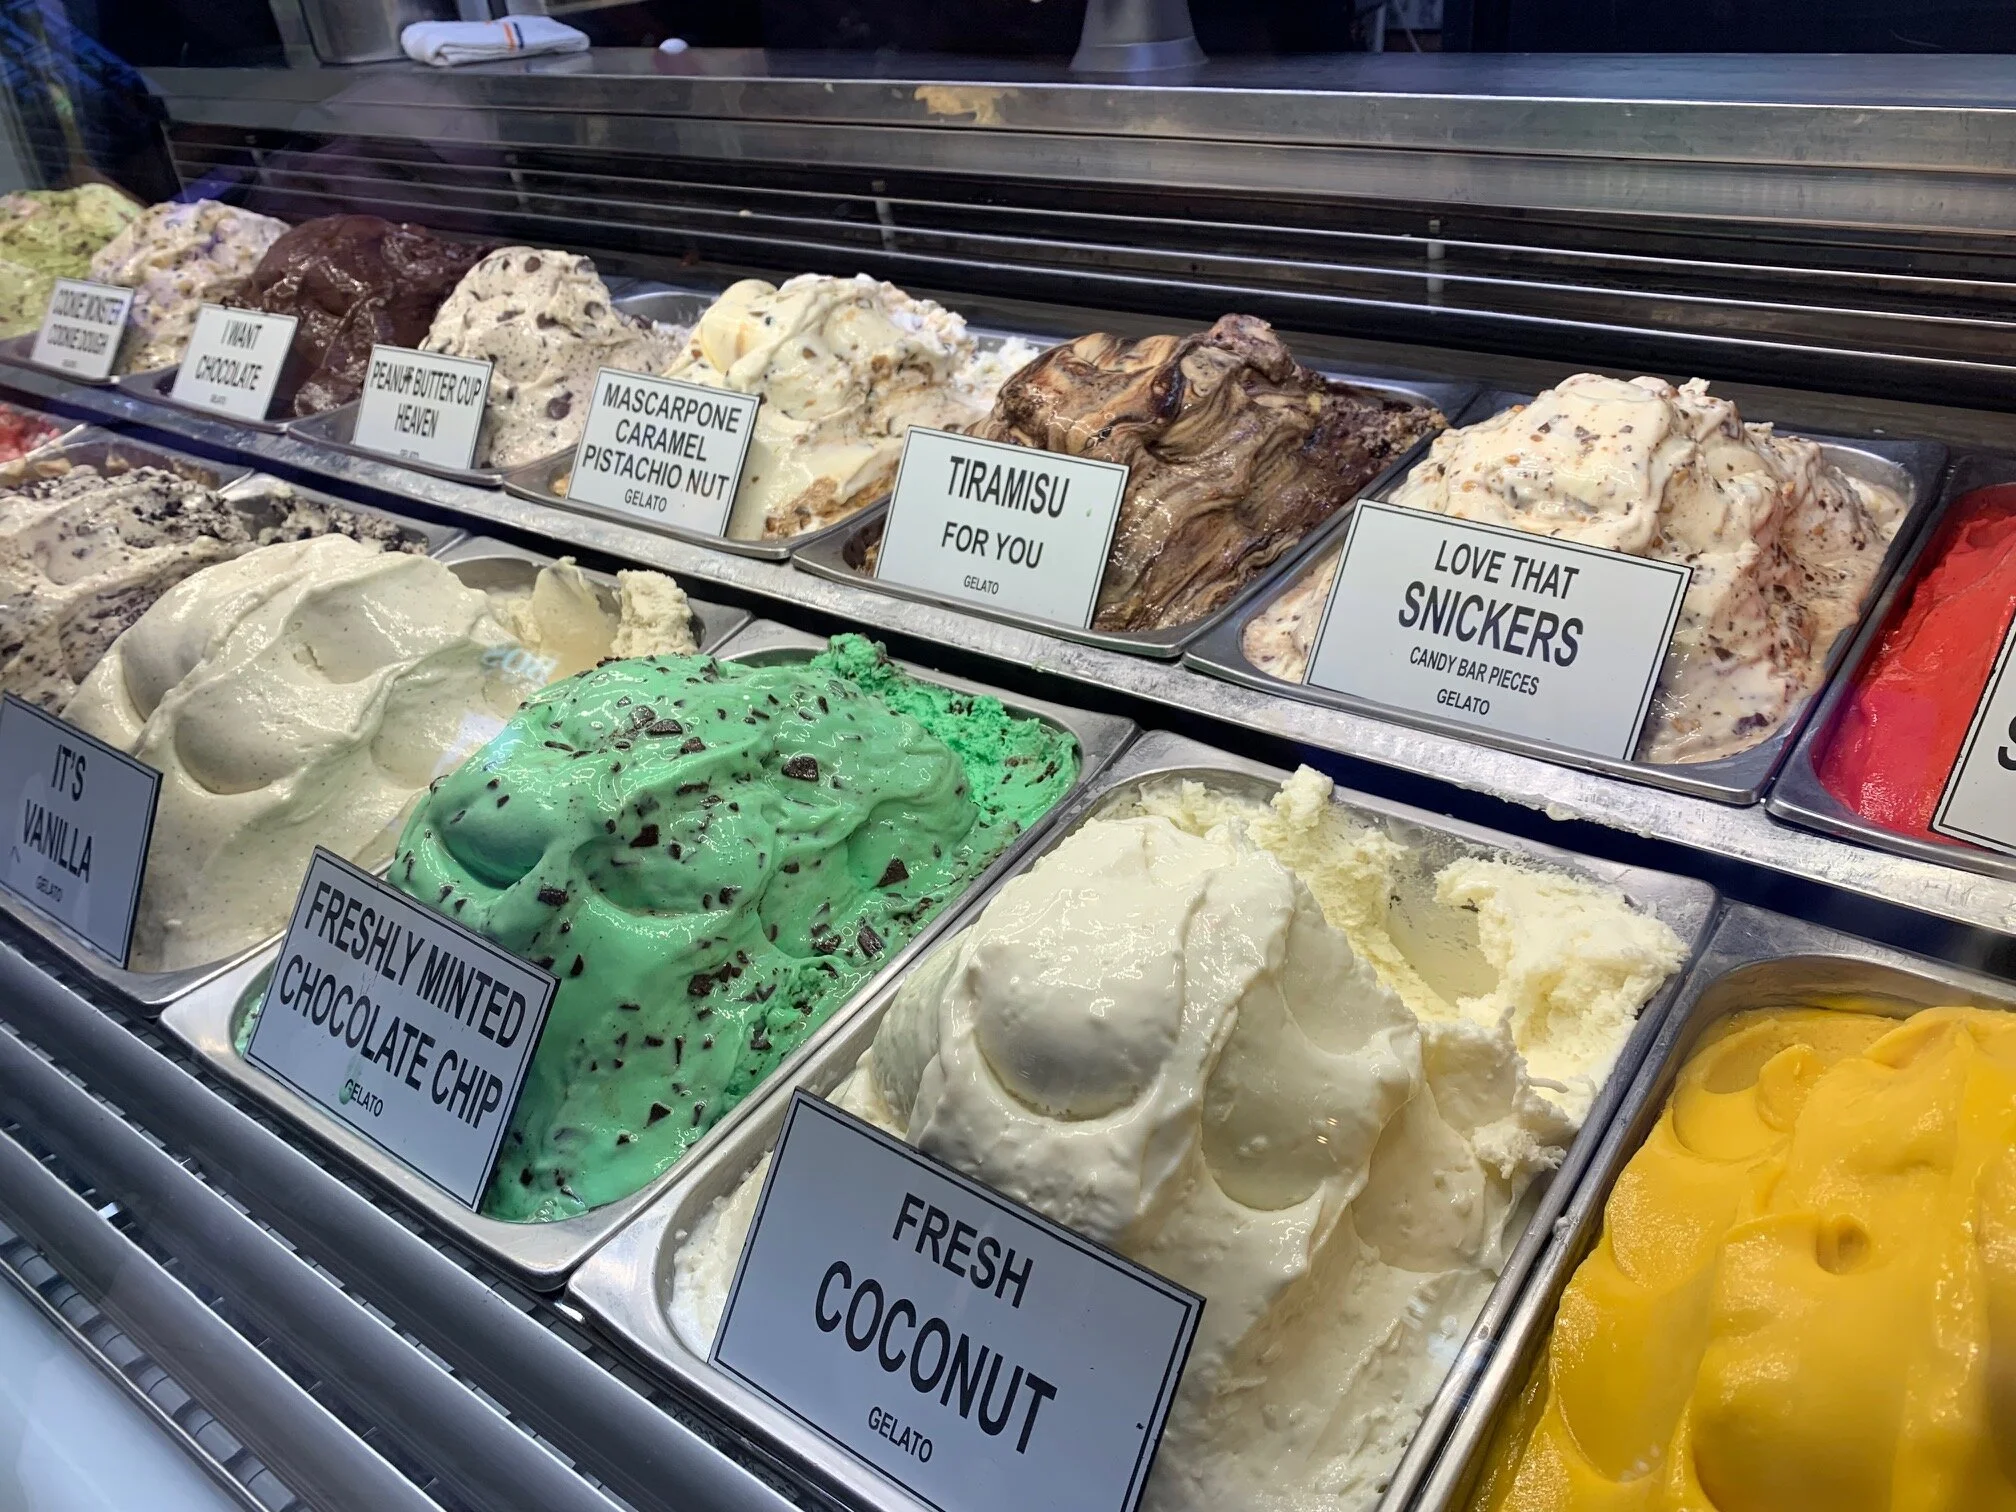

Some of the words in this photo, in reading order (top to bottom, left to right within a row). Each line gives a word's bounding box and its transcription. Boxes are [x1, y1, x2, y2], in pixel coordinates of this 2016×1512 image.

[221, 319, 231, 344] I
[226, 320, 263, 351] WANT
[195, 354, 263, 391] CHOCOLATE
[370, 360, 415, 395] PEANUT
[412, 368, 457, 403] BUTTER
[457, 375, 482, 407] CUP
[394, 402, 440, 439] HEAVEN
[602, 382, 742, 434] MASCARPONE
[615, 418, 707, 462] CARAMEL
[582, 444, 683, 489] PISTACHIO
[685, 468, 730, 501] NUT
[947, 455, 1070, 518] TIRAMISU
[624, 488, 668, 513] GELATO
[941, 521, 989, 557] FOR
[996, 532, 1044, 569] YOU
[1433, 539, 1506, 585] LOVE
[1509, 554, 1580, 600] THAT
[963, 574, 999, 596] GELATO
[1397, 580, 1584, 668] SNICKERS
[1409, 646, 1458, 674] CANDY
[1456, 657, 1488, 684] BAR
[1488, 665, 1540, 697] PIECES
[1436, 688, 1490, 717] GELATO
[51, 743, 87, 802] IT'S
[23, 798, 93, 884] VANILLA
[304, 880, 426, 987] FRESHLY
[415, 943, 527, 1049] MINTED
[279, 954, 437, 1092] CHOCOLATE
[431, 1048, 504, 1130] CHIP
[344, 1077, 384, 1118] GELATO
[891, 1191, 1034, 1309] FRESH
[815, 1260, 1059, 1455] COCONUT
[867, 1405, 934, 1464] GELATO
